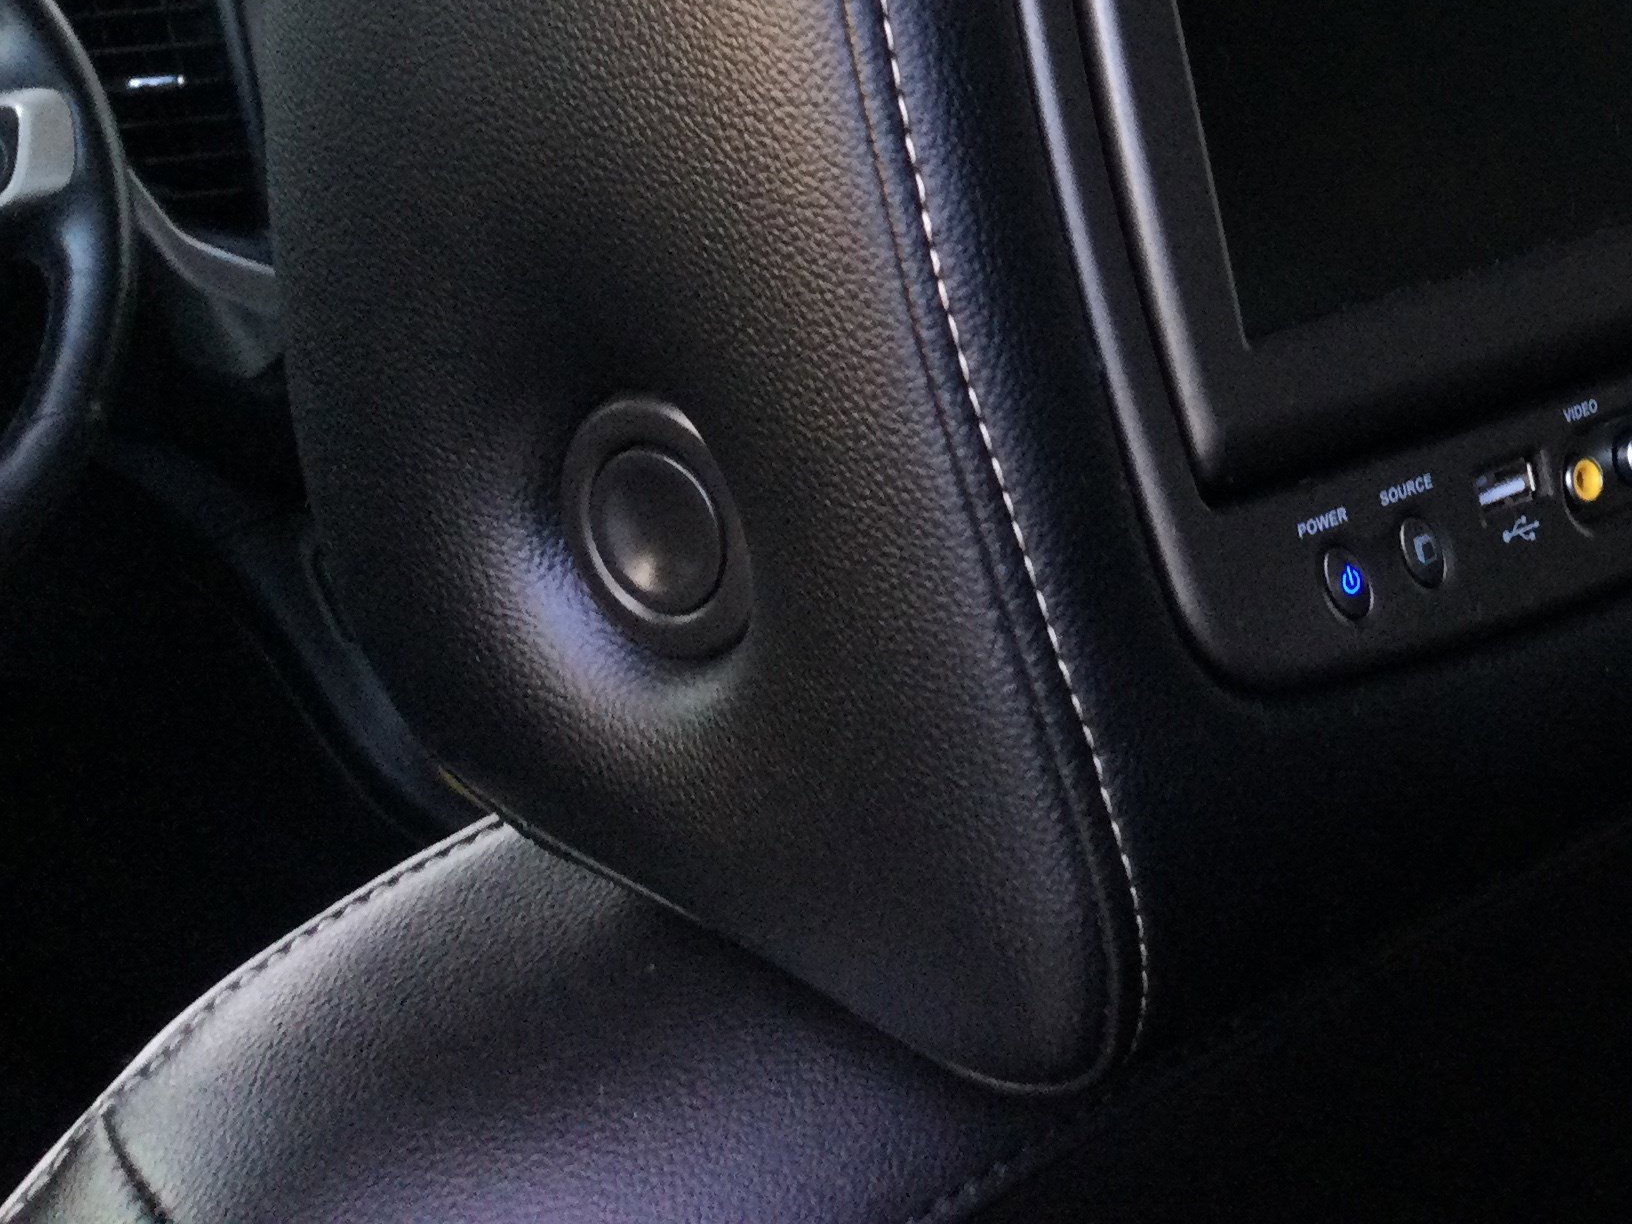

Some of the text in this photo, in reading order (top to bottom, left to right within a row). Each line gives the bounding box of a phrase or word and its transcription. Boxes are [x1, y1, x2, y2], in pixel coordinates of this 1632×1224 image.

[1562, 398, 1598, 423] VIDEO
[1379, 473, 1433, 507] SOURCE
[1297, 505, 1348, 539] POWER
